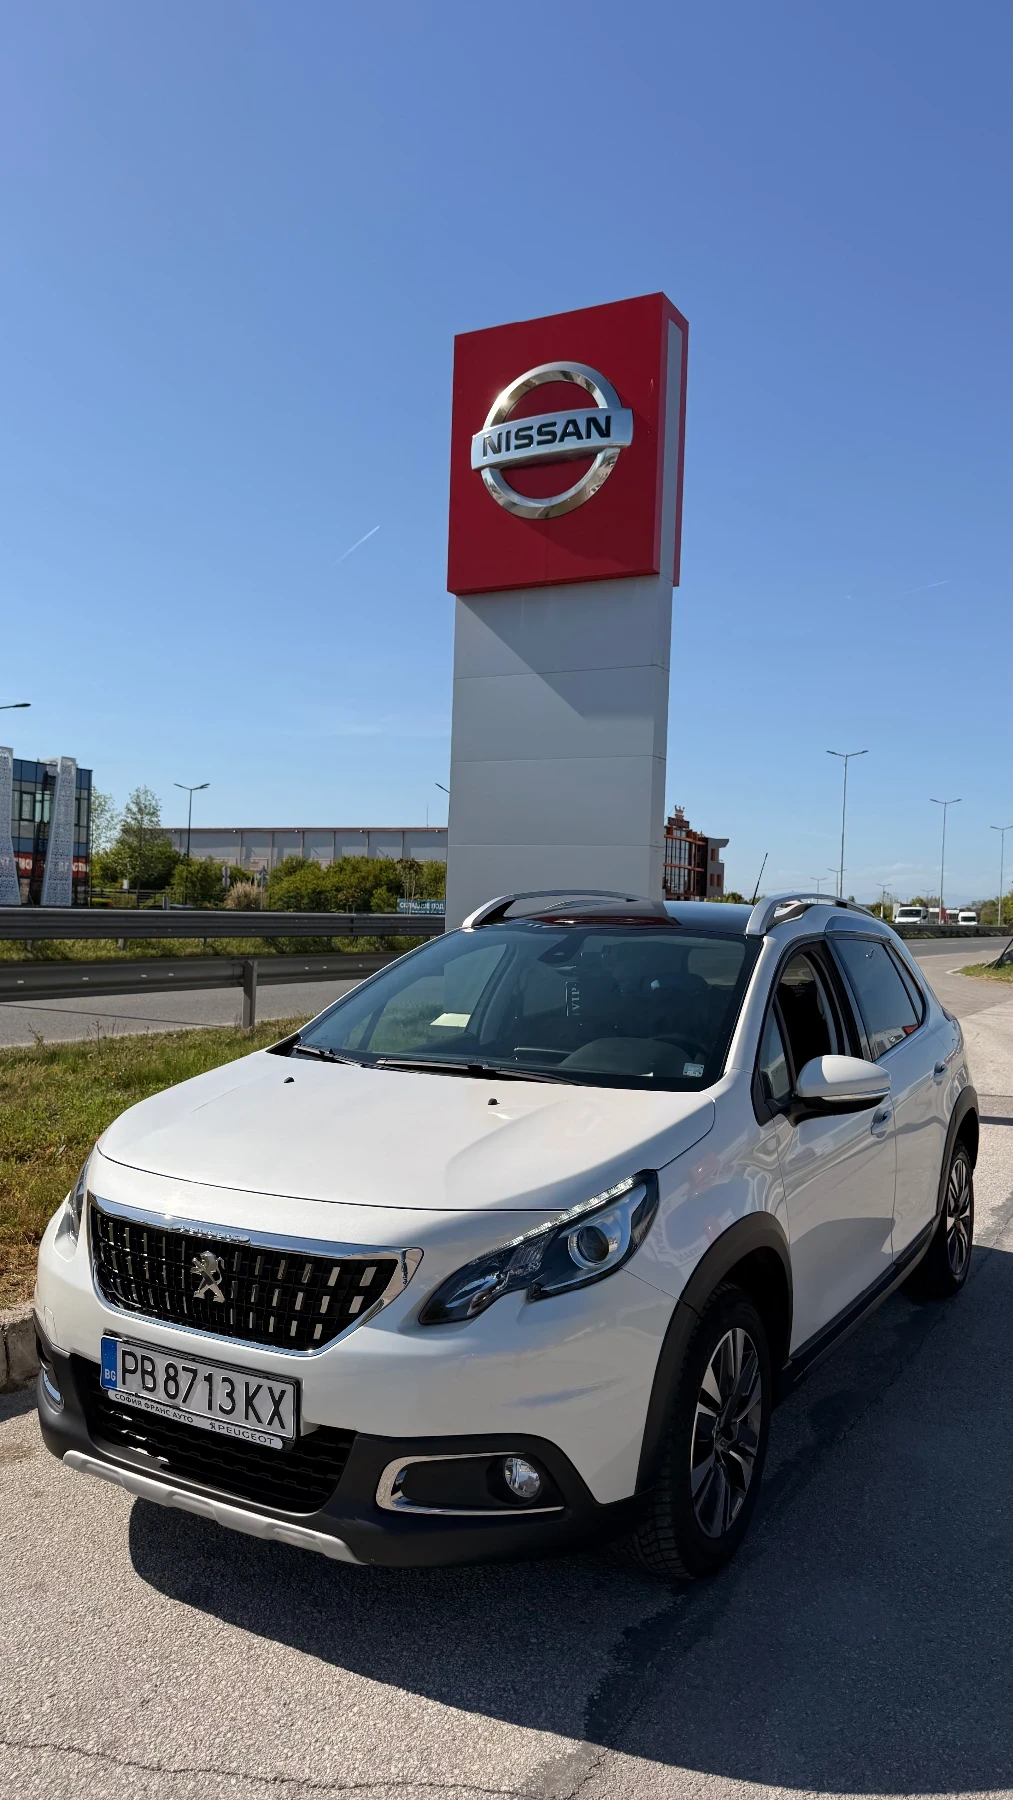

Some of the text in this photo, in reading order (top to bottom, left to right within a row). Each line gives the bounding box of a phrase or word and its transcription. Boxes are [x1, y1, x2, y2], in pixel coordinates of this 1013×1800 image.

[482, 415, 612, 459] NISSAN
[104, 1368, 116, 1382] BG
[121, 1348, 286, 1430] PB 8713 KX
[114, 1393, 194, 1424] СОФИЯ ФРАНС АУТО
[218, 1424, 275, 1445] PEUGEOT
